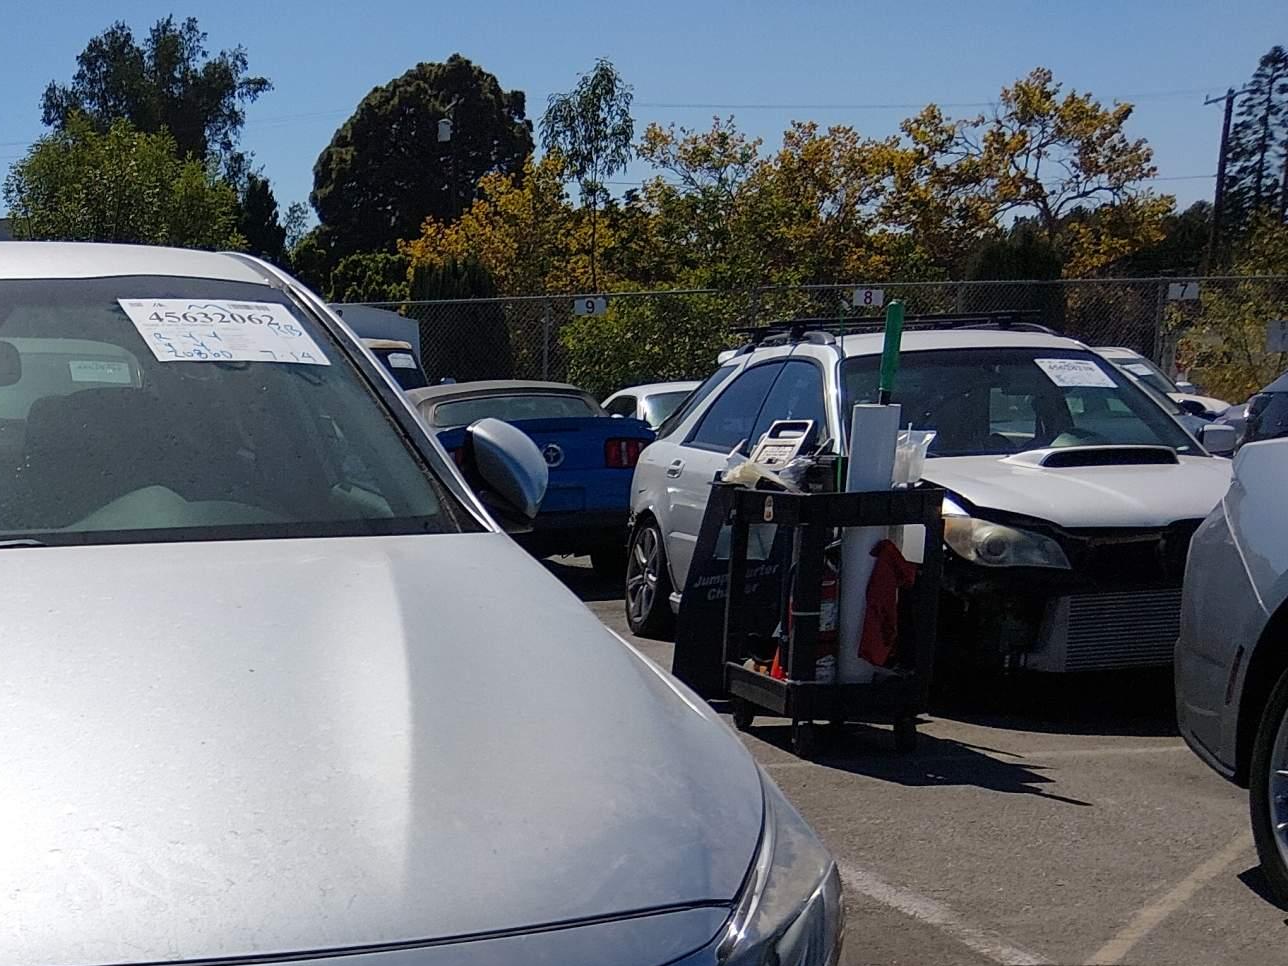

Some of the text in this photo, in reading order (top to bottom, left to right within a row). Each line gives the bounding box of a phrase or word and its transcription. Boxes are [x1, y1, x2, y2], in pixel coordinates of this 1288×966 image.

[864, 290, 872, 304] 8
[1180, 283, 1188, 297] 7
[585, 300, 595, 313] 9
[149, 311, 279, 328] 45632062
